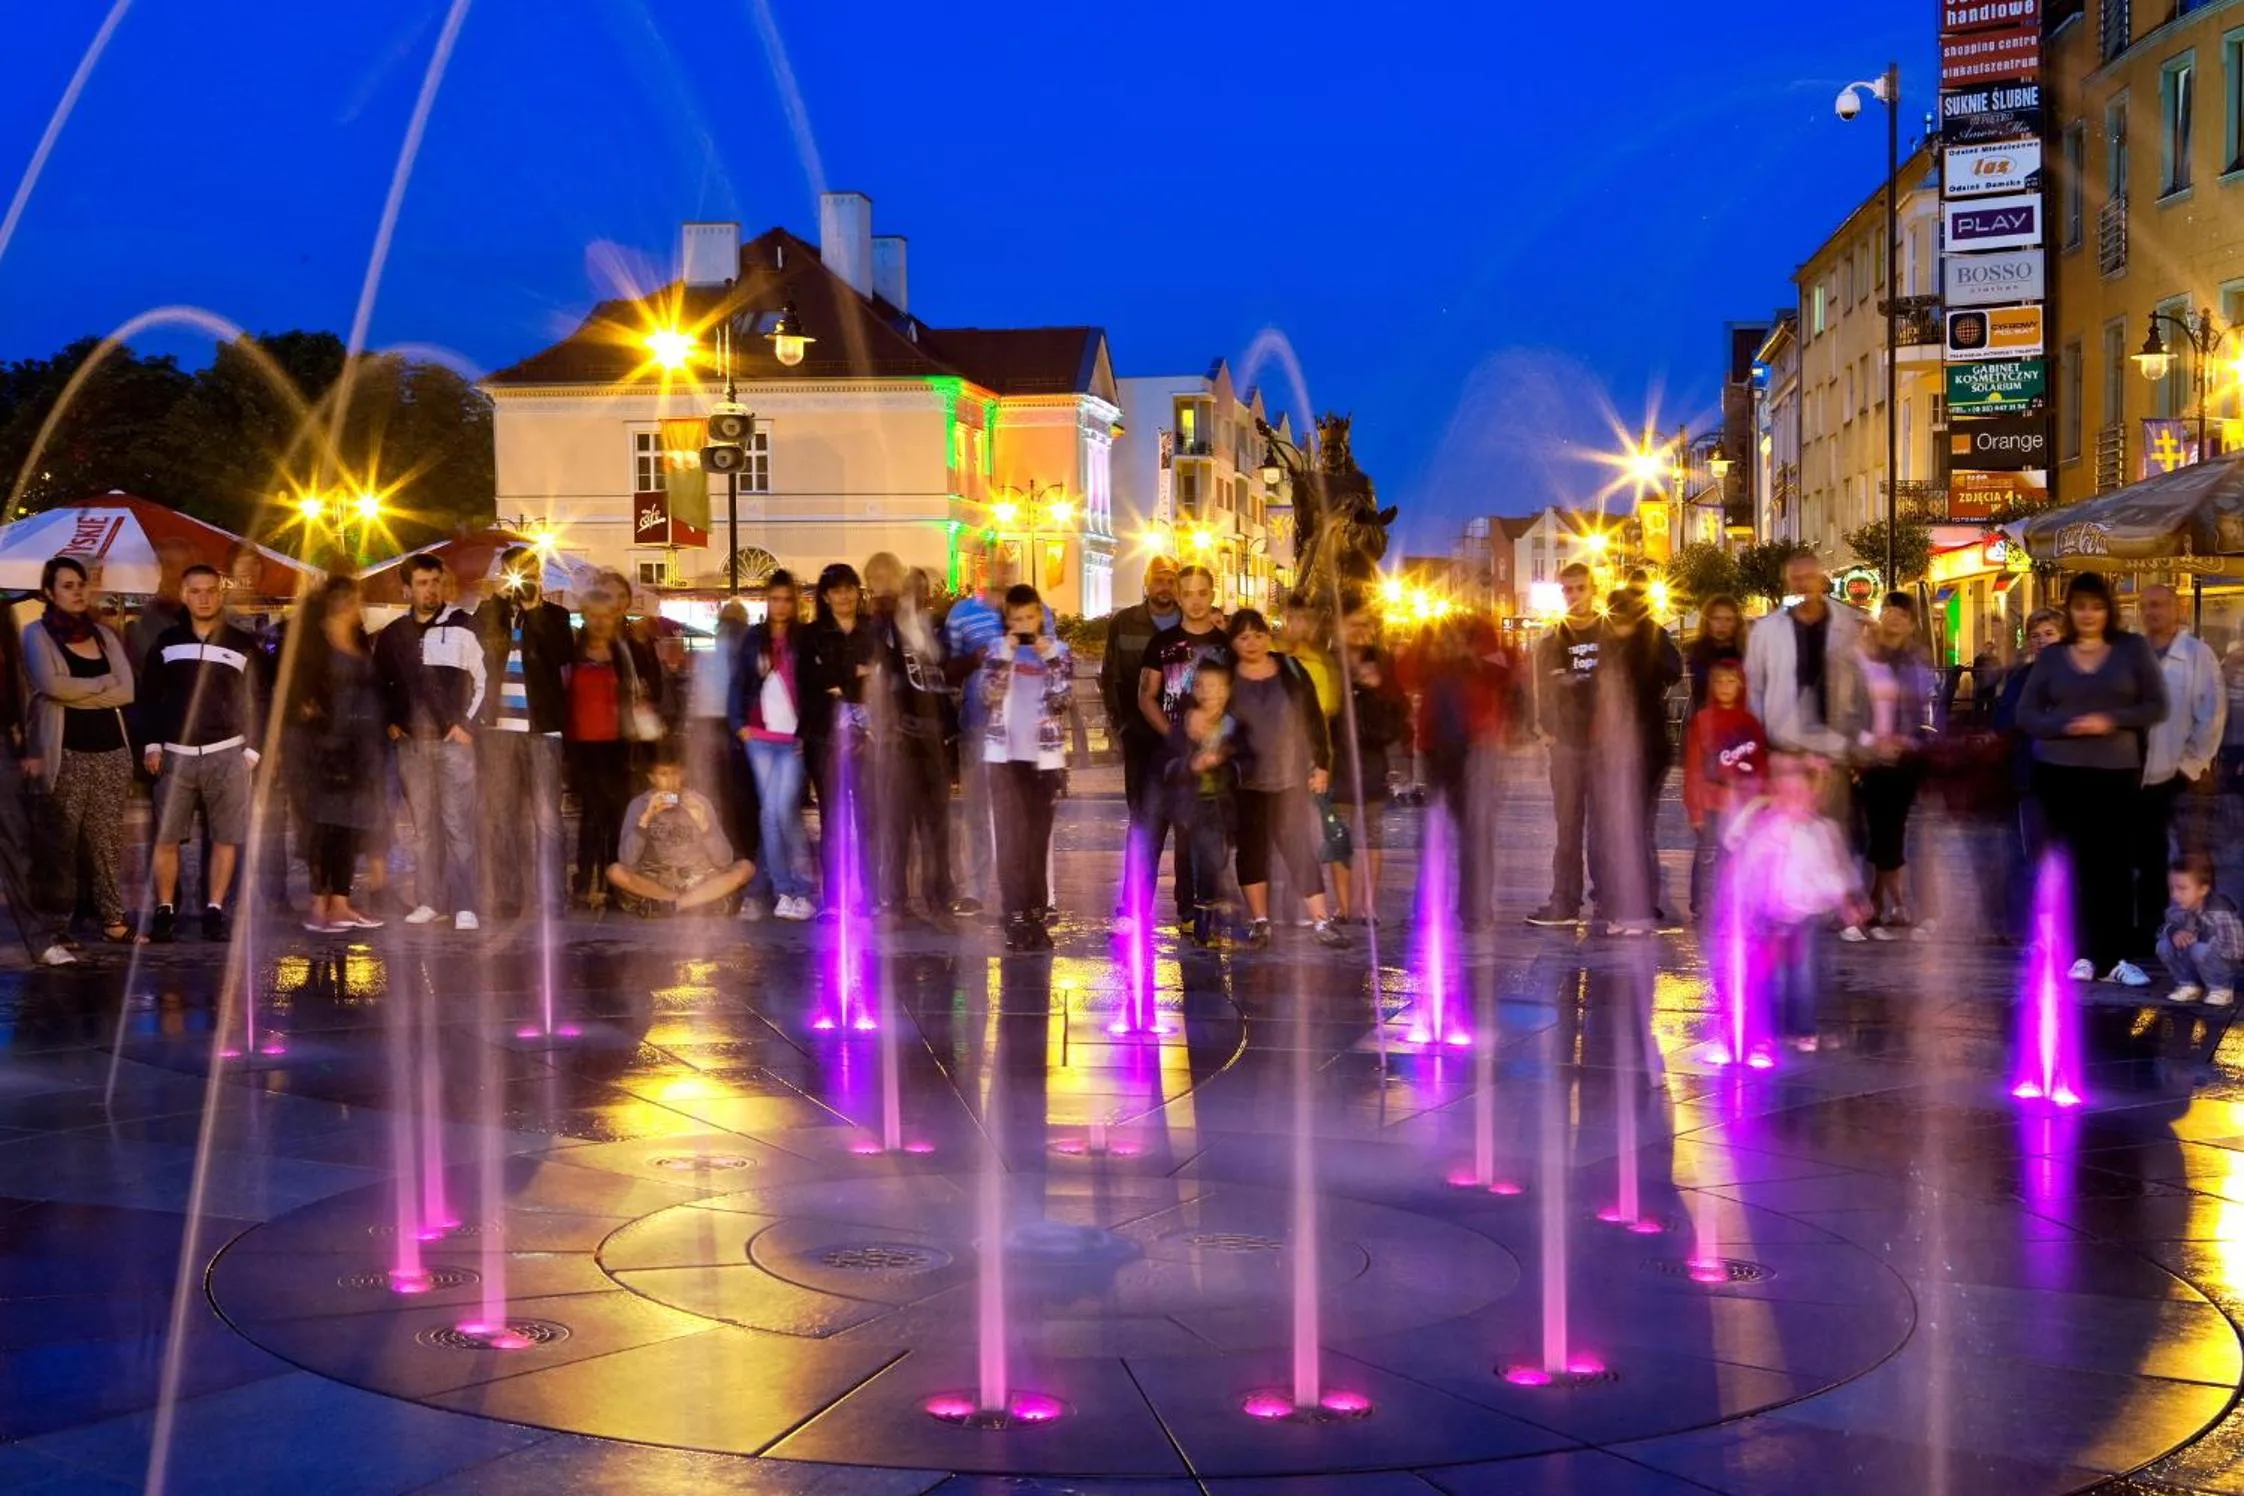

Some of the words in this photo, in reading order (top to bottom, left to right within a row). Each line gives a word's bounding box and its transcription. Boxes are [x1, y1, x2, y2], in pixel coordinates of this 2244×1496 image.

[1947, 0, 2034, 26] handlowe
[1944, 41, 1995, 57] shopping
[1998, 35, 2037, 50] centre
[1943, 57, 2038, 78] einkaufszentrum
[1945, 92, 1988, 116] SUKNIE
[1992, 86, 2039, 110] ŚLUBNE
[1958, 212, 2027, 233] PLAY
[1958, 262, 2032, 283] BOSSO
[1954, 371, 2039, 384] KOSMETYCZNY
[1972, 362, 2020, 375] GABINET
[1971, 382, 2022, 393] SOLARIUM
[1977, 433, 2043, 452] Orange
[1959, 492, 2001, 505] ZDJĘCIA
[219, 575, 253, 589] YSKIE
